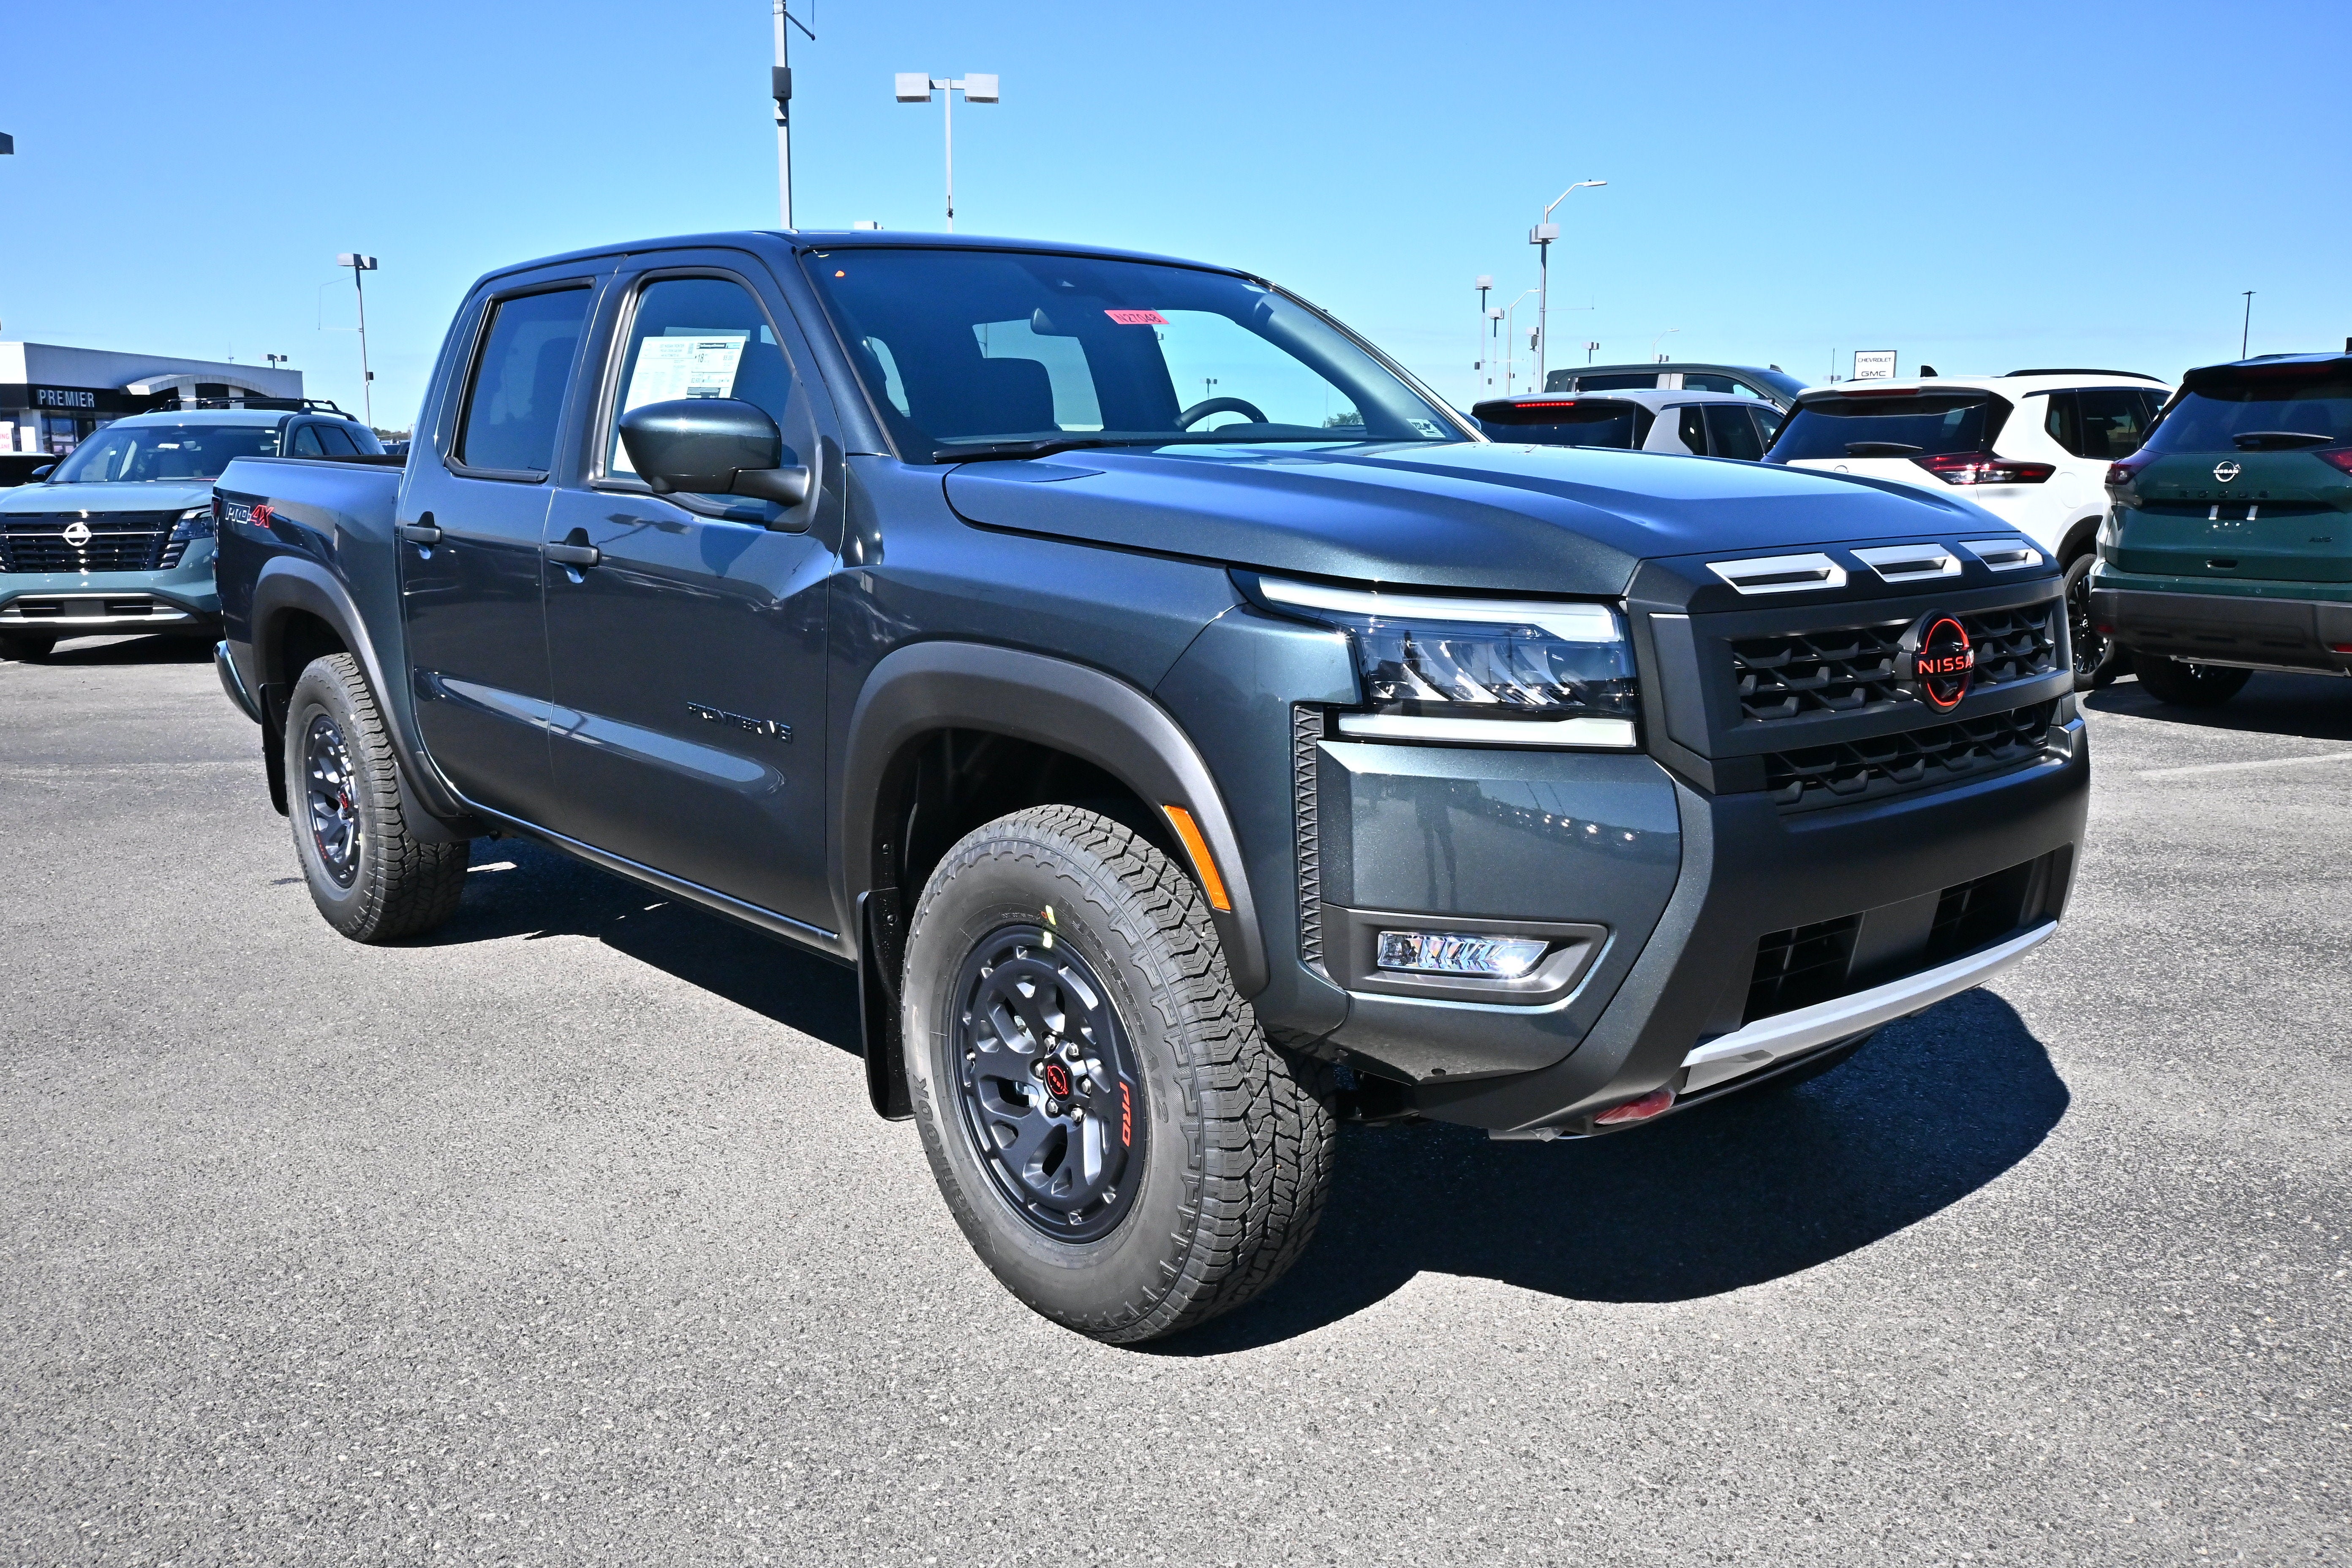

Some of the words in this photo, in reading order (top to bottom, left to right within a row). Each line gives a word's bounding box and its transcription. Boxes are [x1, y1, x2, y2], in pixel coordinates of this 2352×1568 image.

[697, 353, 704, 362] 18
[37, 389, 95, 408] PREMIER
[2179, 490, 2270, 498] ROGUE
[1918, 656, 1974, 674] NISSA
[1119, 1081, 1131, 1147] PRO
